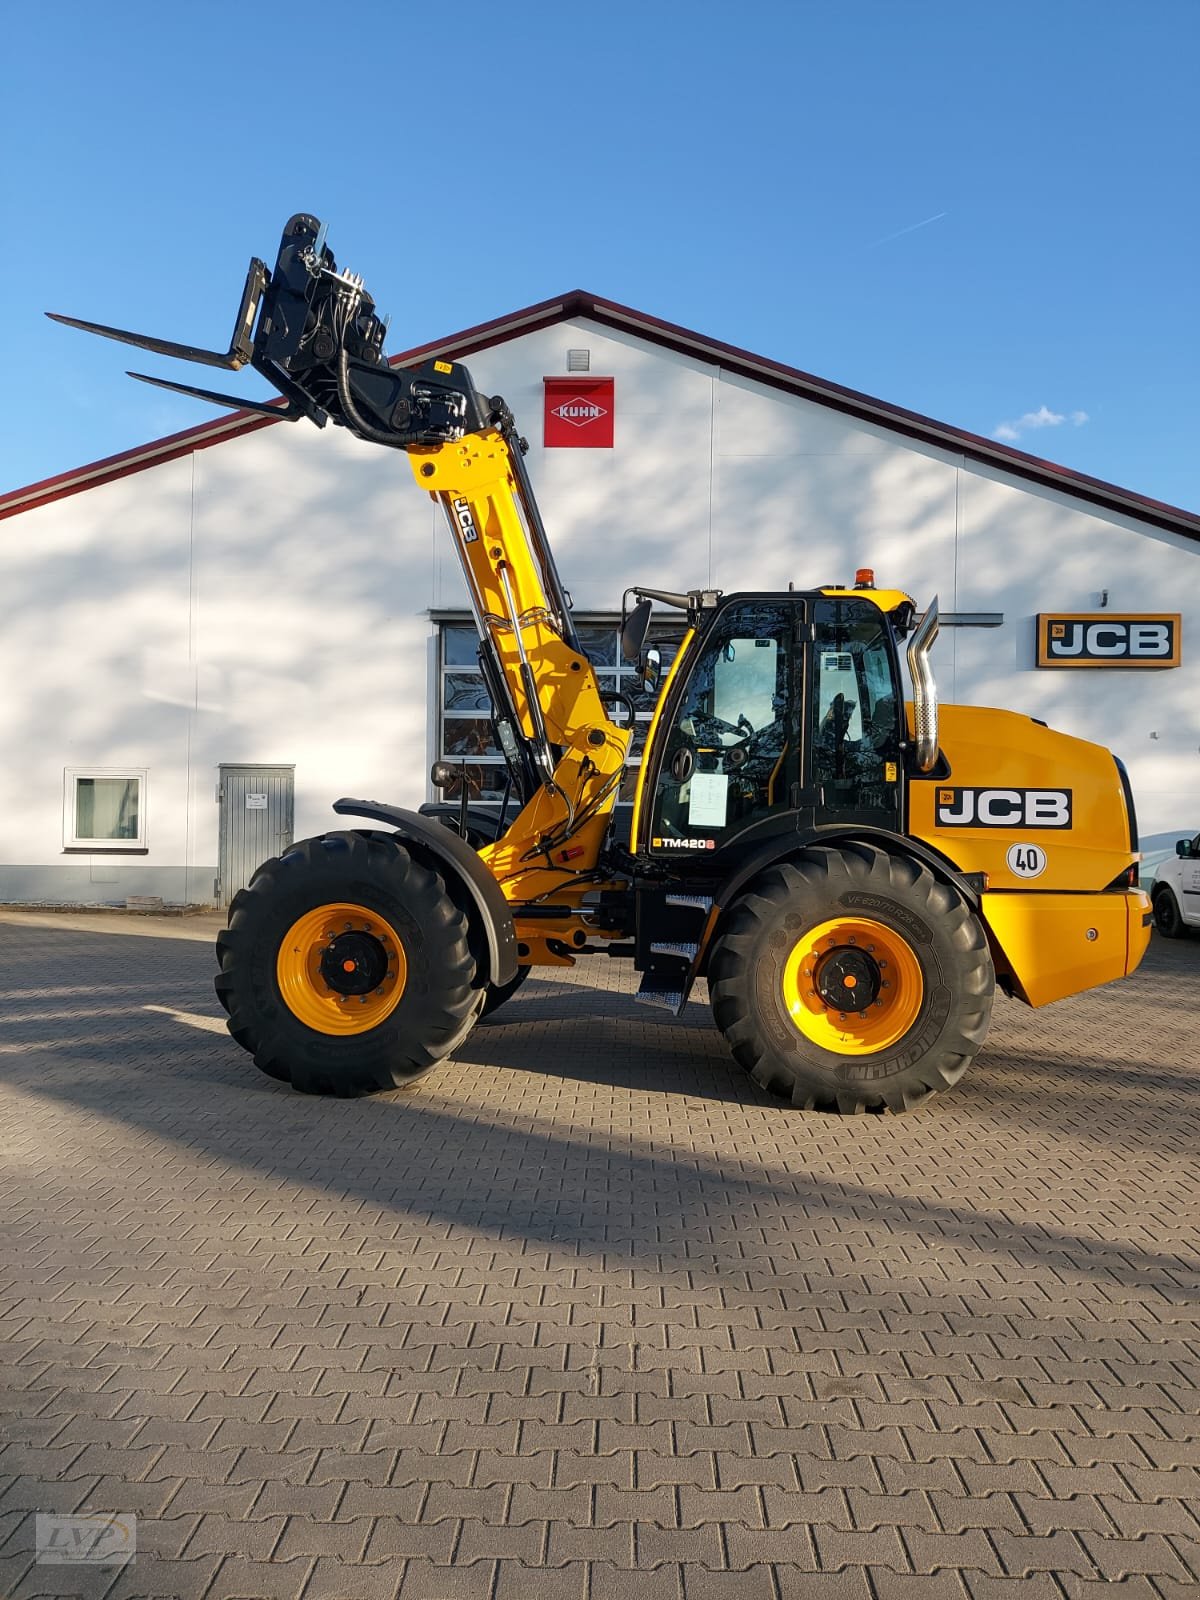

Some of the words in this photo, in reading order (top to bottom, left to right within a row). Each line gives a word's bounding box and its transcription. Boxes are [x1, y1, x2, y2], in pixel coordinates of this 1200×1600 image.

[559, 406, 599, 417] KUHN
[454, 499, 478, 542] JCB
[1051, 623, 1170, 656] JCB
[939, 790, 1070, 826] JCB
[1016, 848, 1038, 871] 40
[847, 1018, 941, 1080] MICHELIN
